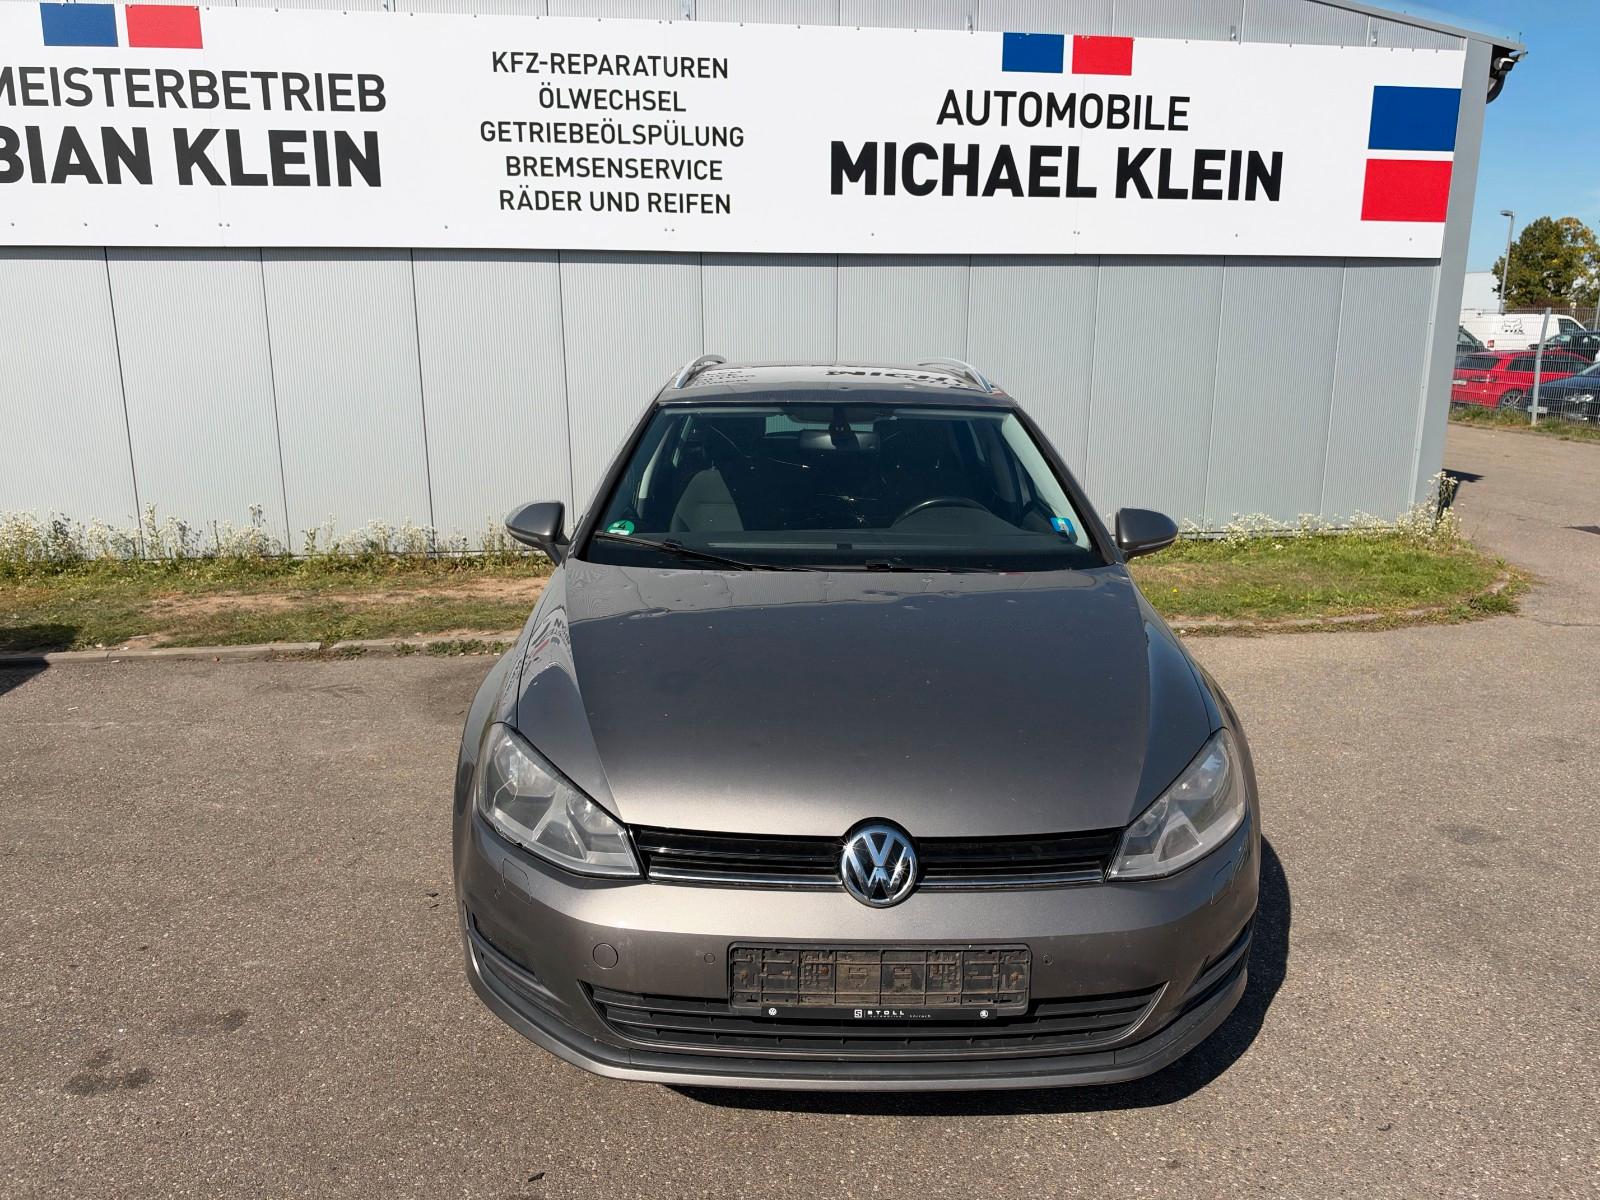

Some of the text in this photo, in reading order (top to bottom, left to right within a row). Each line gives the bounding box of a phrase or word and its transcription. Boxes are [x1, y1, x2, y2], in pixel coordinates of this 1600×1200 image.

[492, 51, 728, 79] KFZ-REPARATUREN
[538, 86, 687, 112] ÖLWECHSEL
[937, 88, 1191, 132] AUTOMOBILE
[480, 119, 744, 148] GETRIEBEÖLSPÜLUNG
[173, 127, 382, 188] KLEIN
[506, 155, 723, 181] BREMSENSERVICE
[830, 140, 1284, 202] MICHAEL KLEIN
[499, 189, 731, 215] RÄDER UND REIFEN
